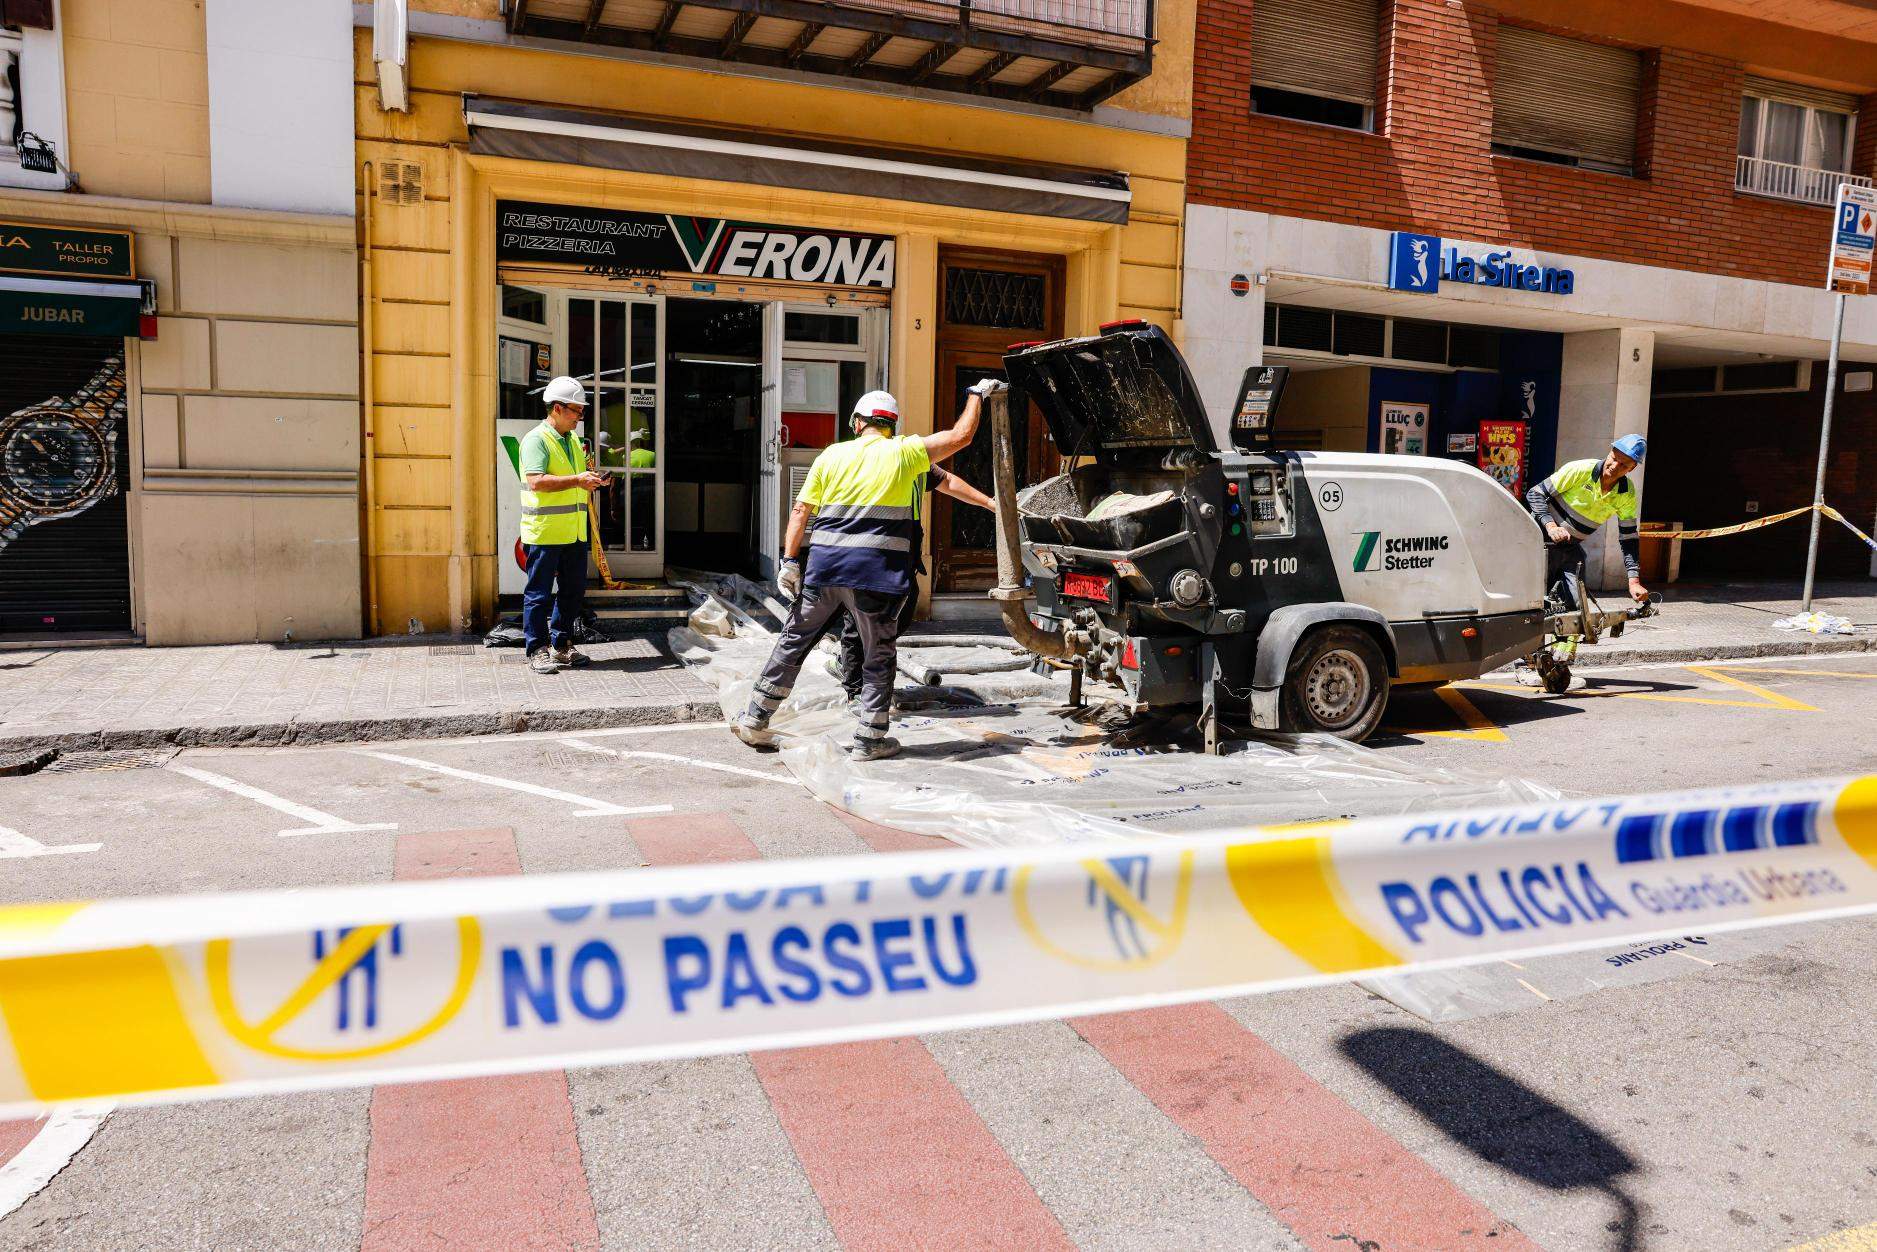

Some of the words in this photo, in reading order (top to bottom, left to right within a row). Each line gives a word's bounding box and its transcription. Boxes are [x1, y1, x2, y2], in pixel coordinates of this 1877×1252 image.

[503, 213, 667, 238] RESTAURANT
[51, 241, 113, 255] TALLER
[503, 233, 616, 255] PIZZERIA
[664, 213, 895, 288] VERONA
[59, 254, 109, 265] PROPIO
[1442, 247, 1475, 284] la
[1481, 251, 1575, 295] Sirena
[21, 306, 85, 323] JUBAR
[915, 318, 922, 330] 3
[1632, 348, 1640, 362] 5
[1385, 413, 1410, 426] LLUÇ
[1322, 491, 1340, 502] 05
[1385, 536, 1449, 553] SCHWING
[1250, 558, 1268, 576] TP
[1273, 557, 1298, 575] 100
[1385, 555, 1435, 571] Stetter
[1380, 862, 1628, 944] POLICIA
[1631, 876, 1749, 915] Guàrdia
[1745, 868, 1847, 902] Urbana
[1606, 941, 1687, 968] PROLIANS
[499, 943, 627, 1028] NO
[663, 912, 980, 1014] PASSEU
